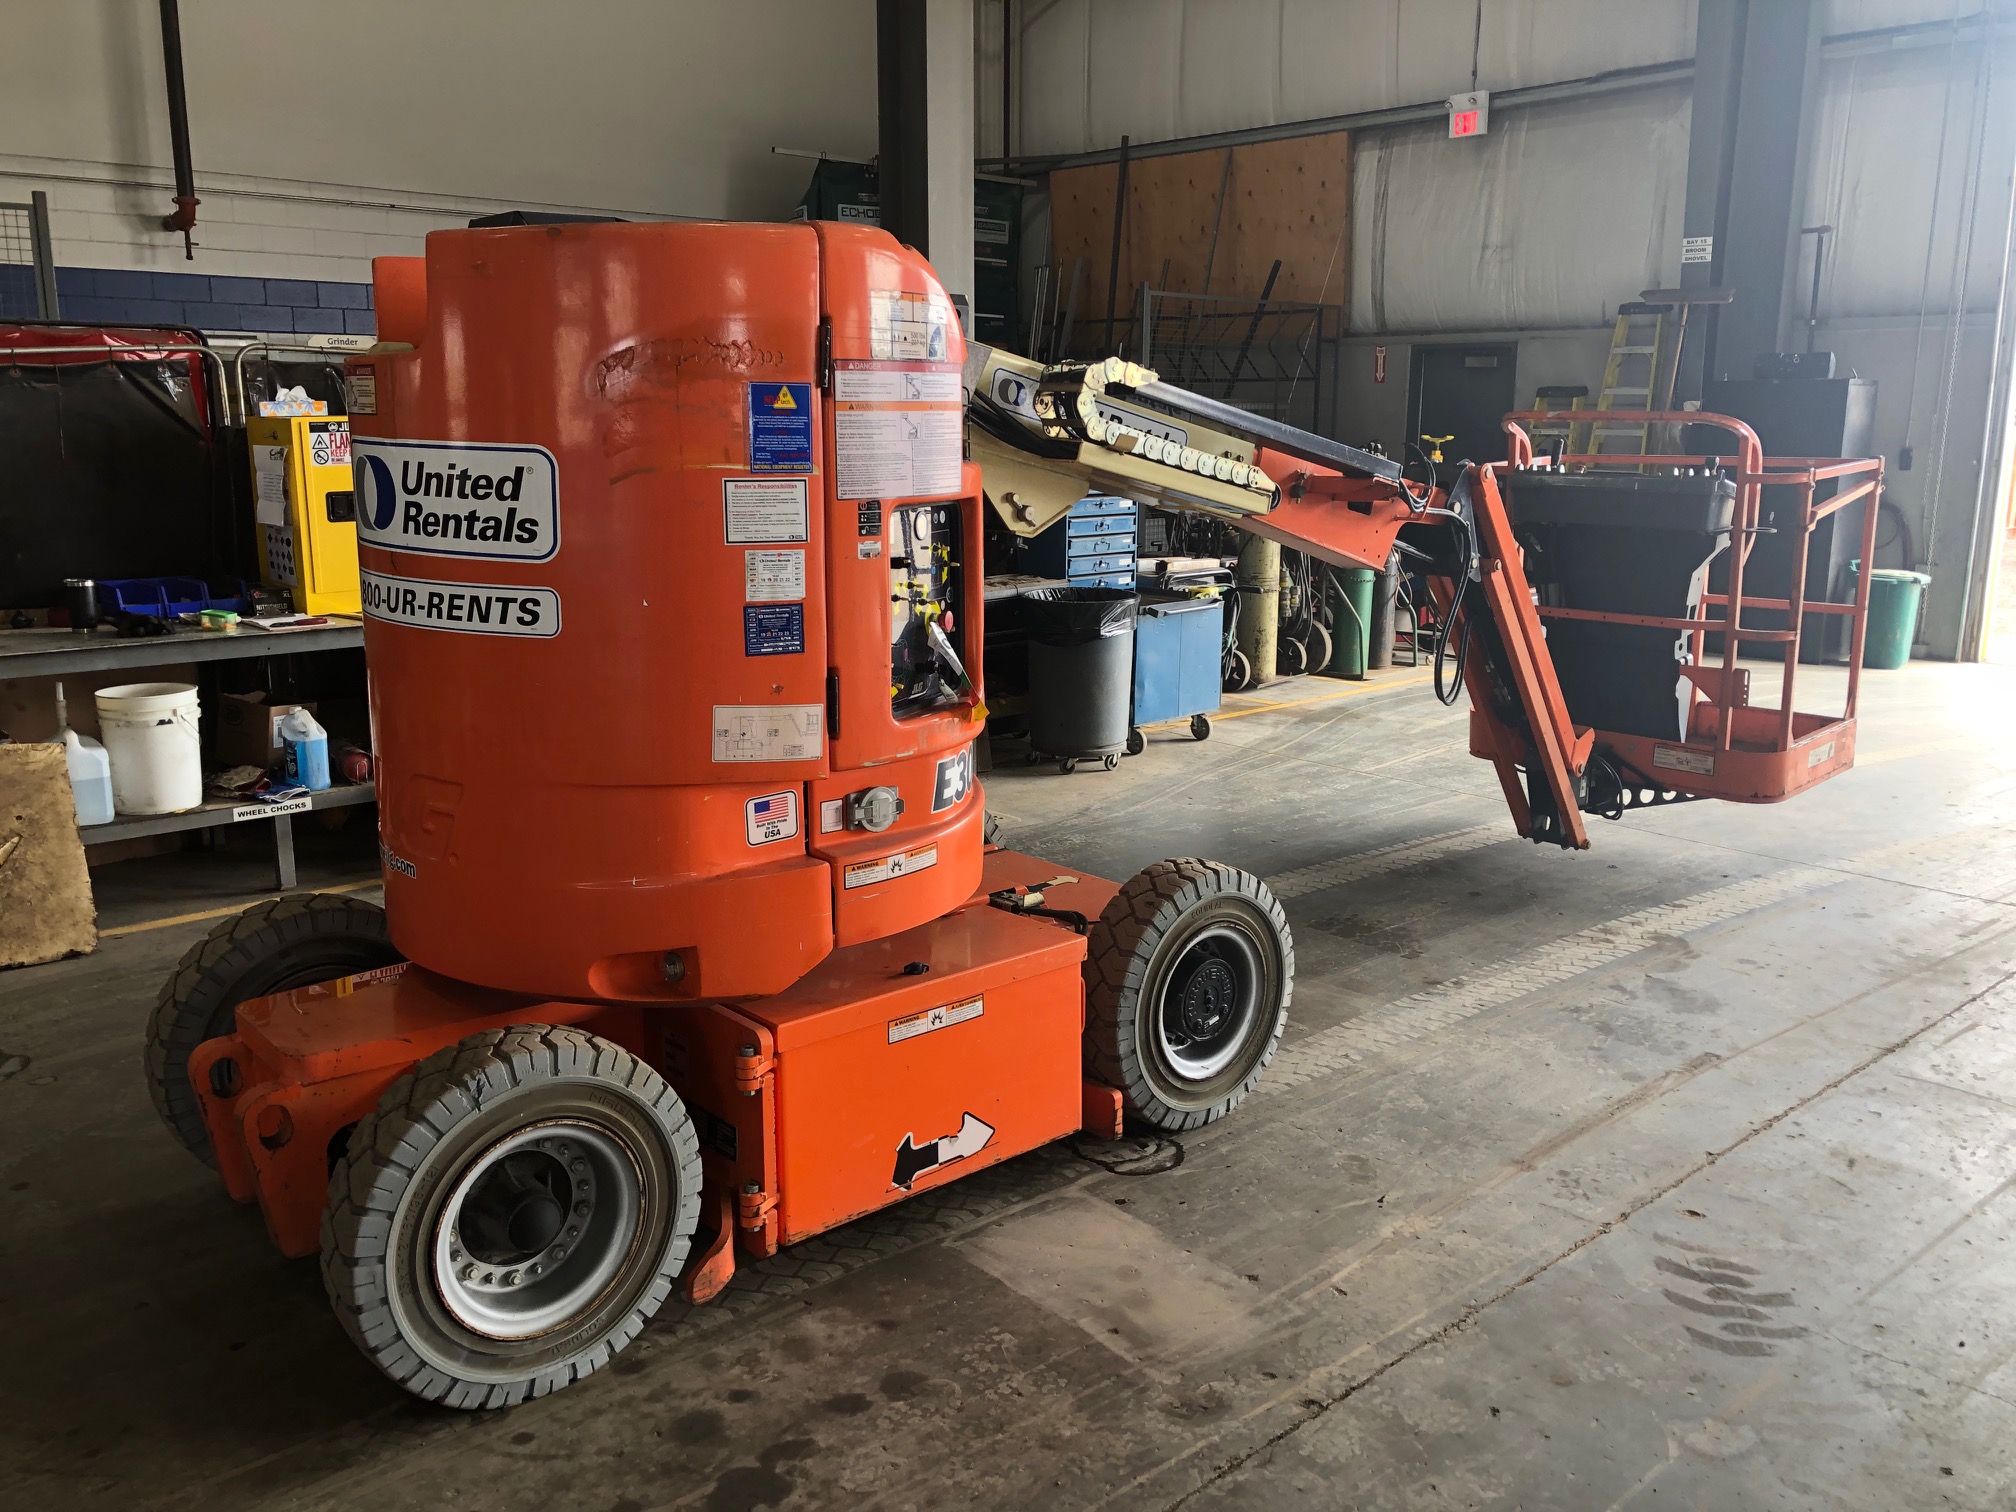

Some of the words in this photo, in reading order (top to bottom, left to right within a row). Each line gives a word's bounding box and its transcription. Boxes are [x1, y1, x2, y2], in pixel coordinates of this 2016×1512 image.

[327, 337, 359, 346] Grinder
[855, 362, 881, 370] DANGER
[331, 449, 347, 457] KEEP
[401, 460, 525, 501] United
[402, 501, 539, 544] Rentals
[362, 579, 541, 627] 800-UR-RENTS
[237, 808, 268, 818] WHEEL
[270, 802, 307, 813] CHOCKS
[764, 829, 781, 838] USA
[856, 862, 879, 870] WARNING
[898, 1015, 920, 1025] WARNING
